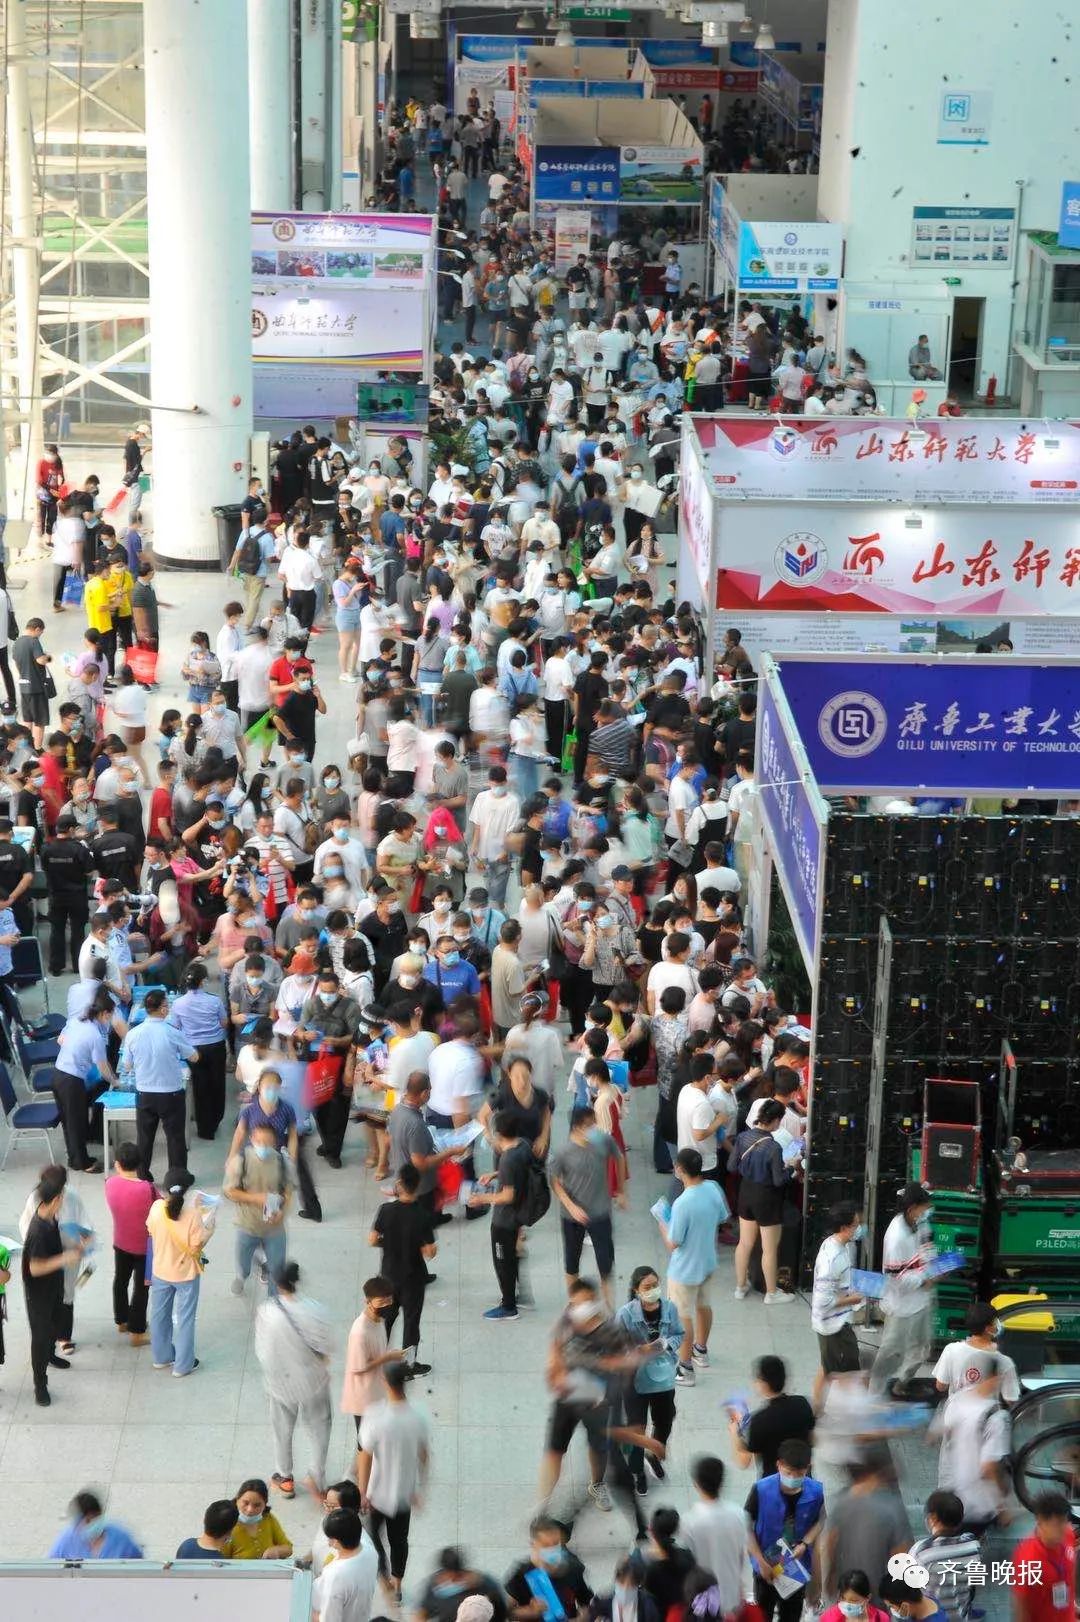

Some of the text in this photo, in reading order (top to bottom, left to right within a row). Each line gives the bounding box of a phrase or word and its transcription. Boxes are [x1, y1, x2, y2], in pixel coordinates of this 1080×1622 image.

[897, 740, 924, 751] QILU
[930, 740, 997, 752] UNIVERSITY
[1003, 742, 1018, 752] OF
